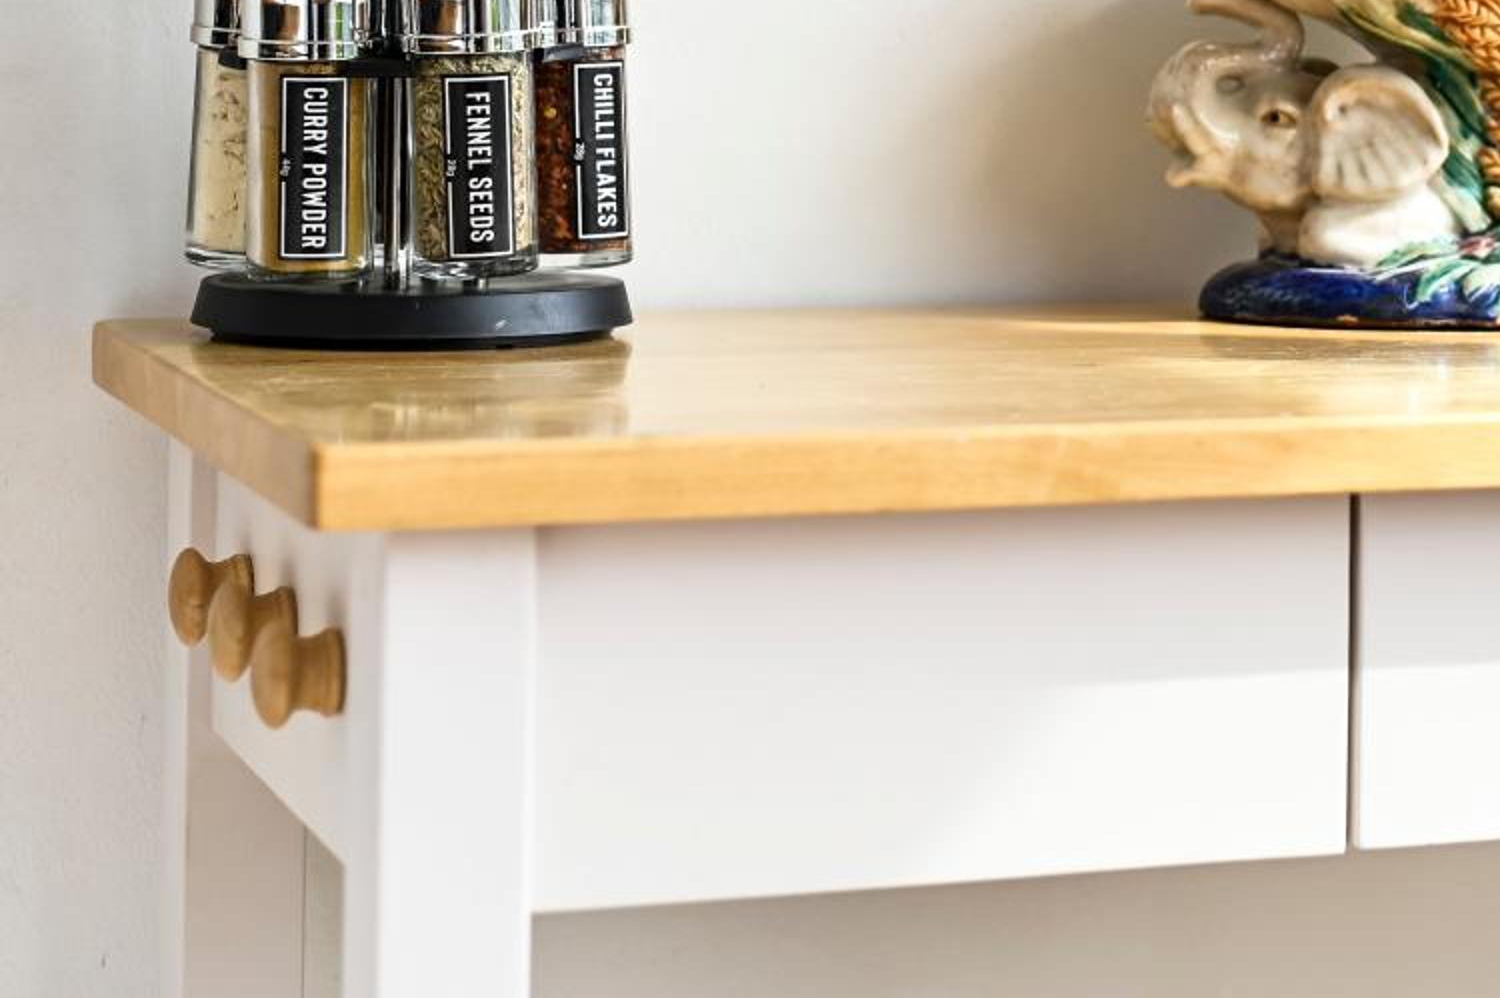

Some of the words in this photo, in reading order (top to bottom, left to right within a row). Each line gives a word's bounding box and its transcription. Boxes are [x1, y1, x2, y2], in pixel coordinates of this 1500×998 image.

[303, 87, 329, 155] CURRY
[465, 91, 492, 171] FENNEL
[593, 73, 615, 140] CHILLI
[301, 163, 327, 249] POWDER
[468, 177, 495, 243] SEEDS
[595, 147, 618, 228] FLAKES
